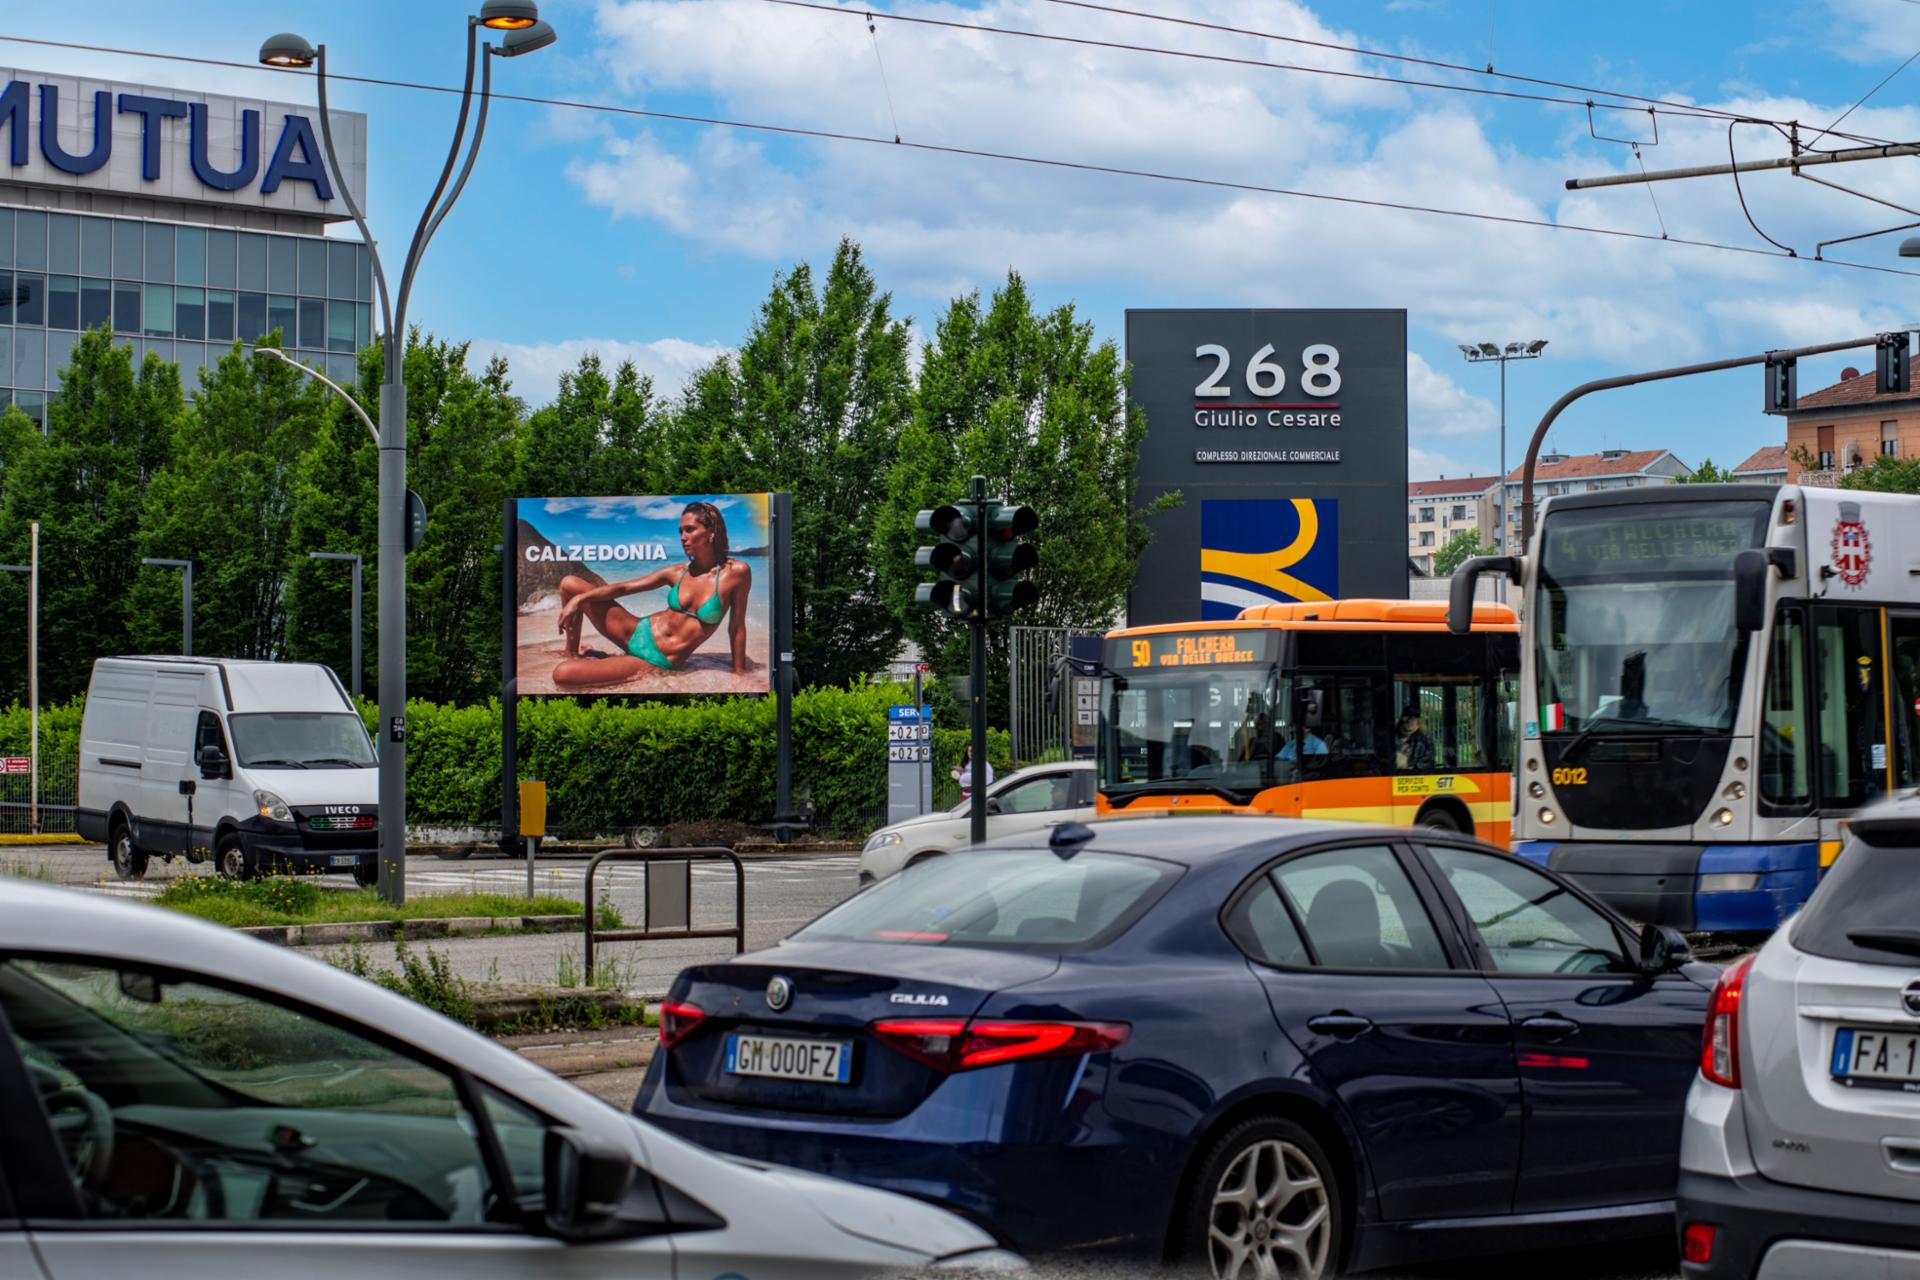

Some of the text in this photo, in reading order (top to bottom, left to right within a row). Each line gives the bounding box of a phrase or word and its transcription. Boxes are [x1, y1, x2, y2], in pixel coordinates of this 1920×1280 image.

[1195, 343, 1341, 397] 268
[1195, 410, 1341, 426] Giulio Cesare
[1196, 451, 1340, 461] COMPLESSO DIREZIONALE COMMERCIALE
[525, 543, 667, 562] CALZEDONIA
[1132, 635, 1235, 667] 50 FALCHERA
[1553, 767, 1588, 784] 6012
[325, 806, 360, 814] IVECO
[891, 993, 949, 1006] GIULIA
